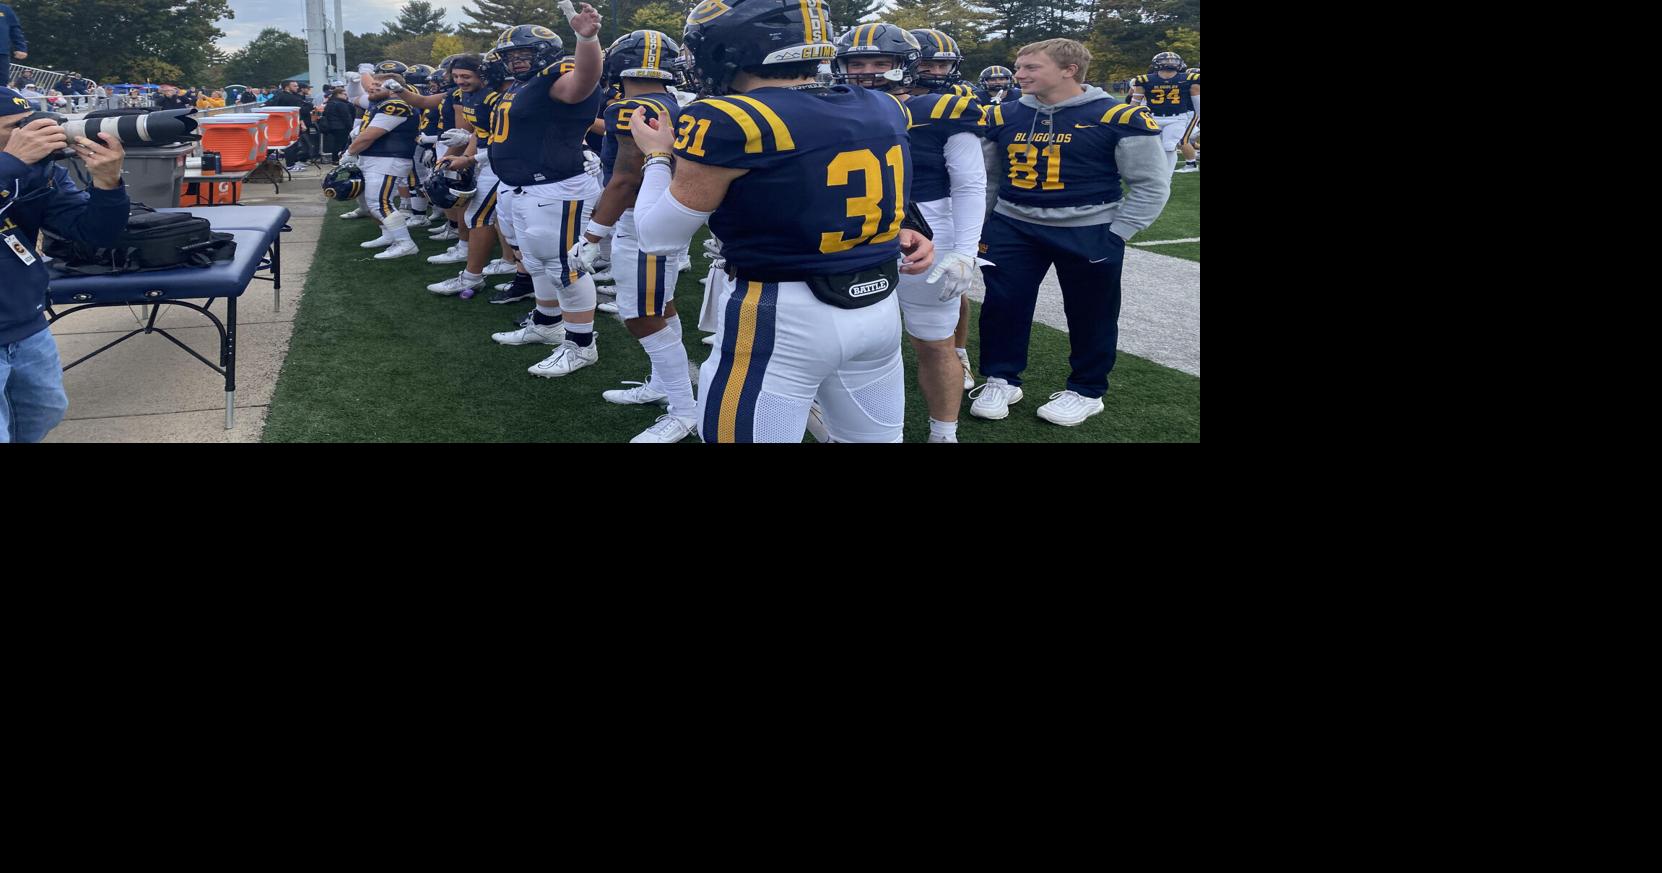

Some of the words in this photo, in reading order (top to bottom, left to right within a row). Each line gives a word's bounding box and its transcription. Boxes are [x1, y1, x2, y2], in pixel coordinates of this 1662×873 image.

[1150, 88, 1180, 104] 34
[383, 105, 407, 116] 97
[673, 114, 712, 157] 31
[1007, 143, 1065, 190] 81
[218, 181, 229, 193] G
[818, 144, 906, 254] 31
[853, 281, 886, 295] BATTLE
